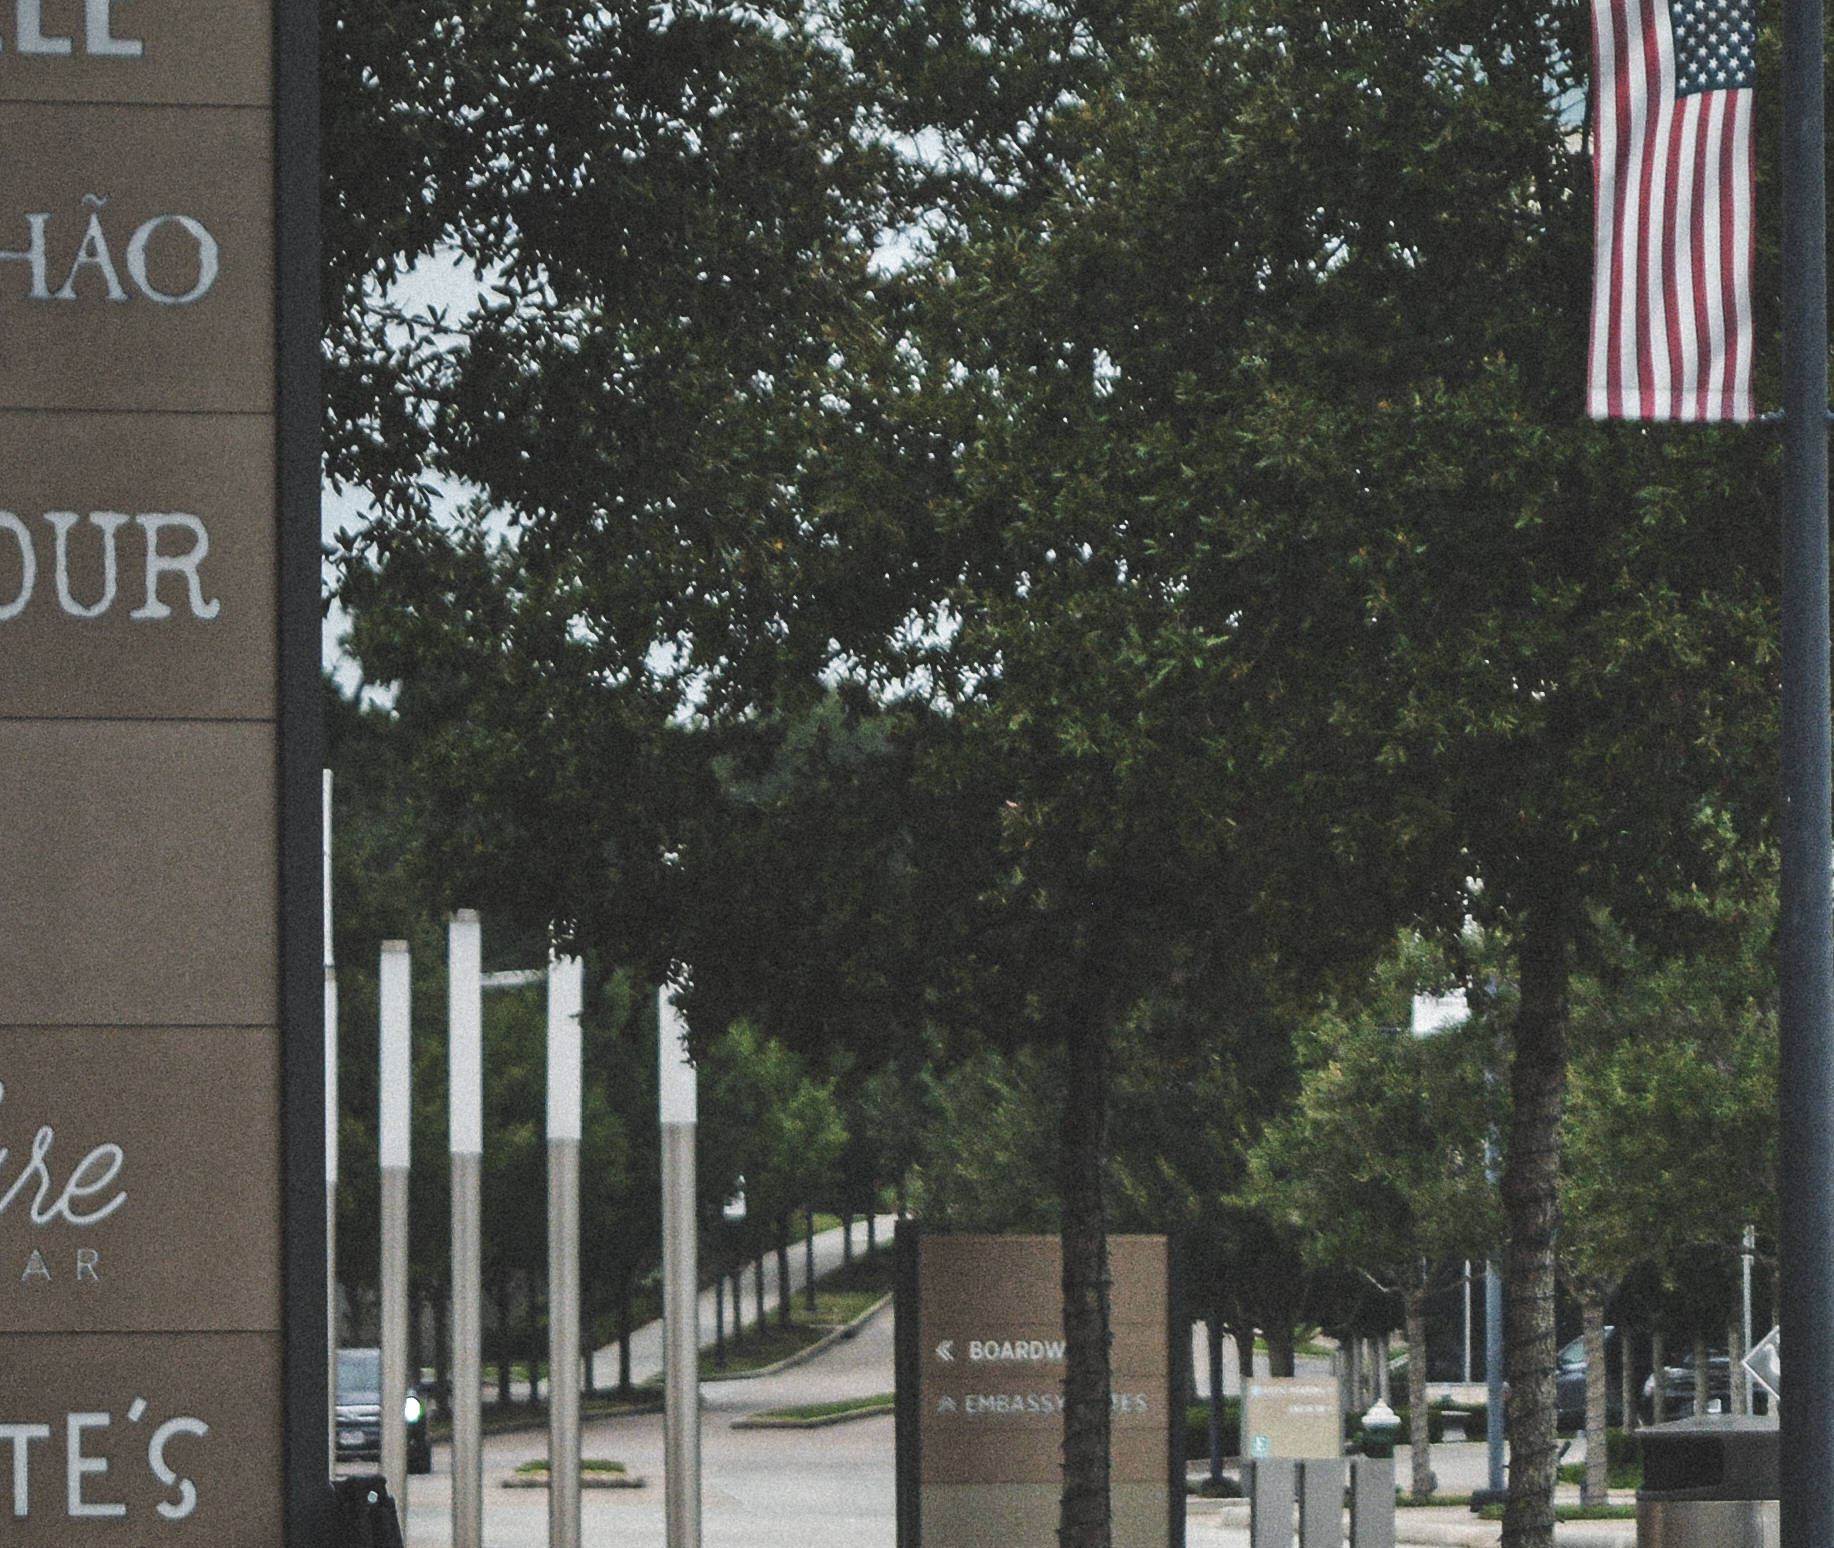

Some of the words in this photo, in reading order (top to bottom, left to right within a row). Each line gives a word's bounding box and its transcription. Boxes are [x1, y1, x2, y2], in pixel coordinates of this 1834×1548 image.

[0, 0, 143, 54] LL
[0, 1125, 127, 1225] re
[969, 1341, 1066, 1360] BOARDW
